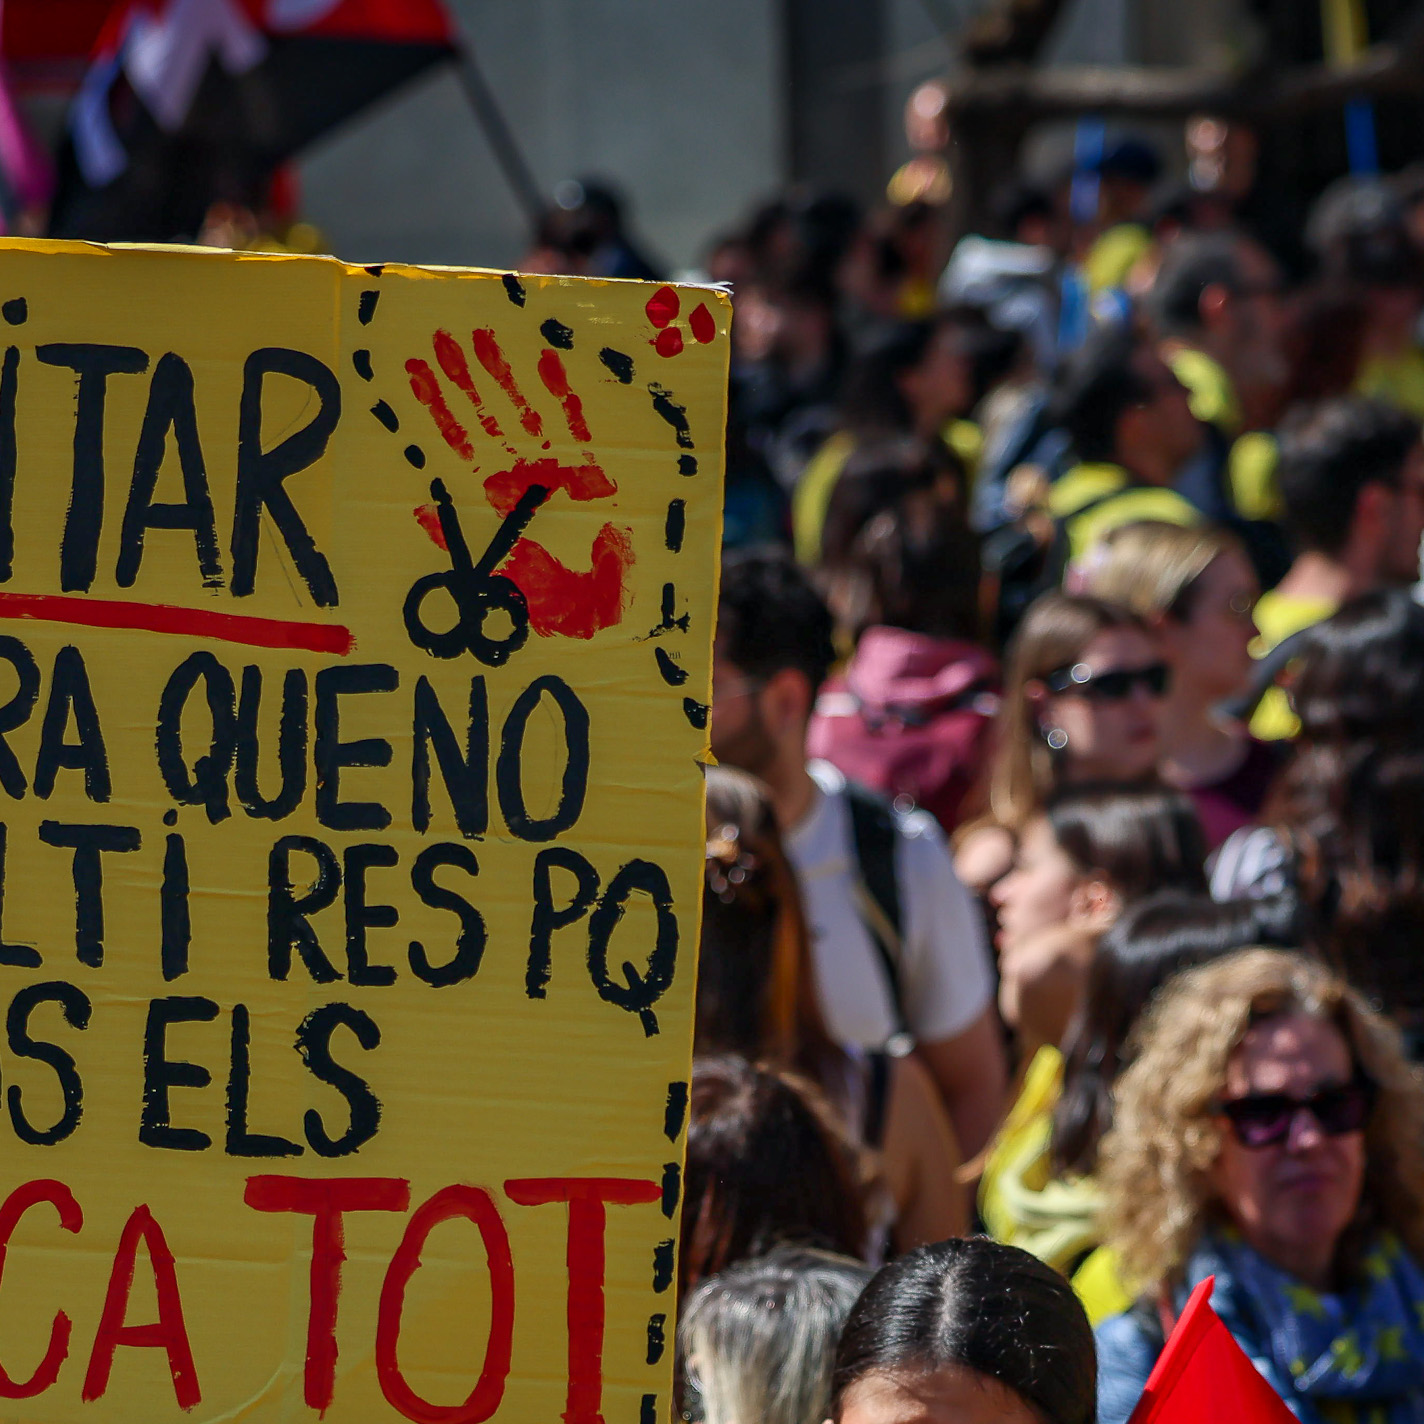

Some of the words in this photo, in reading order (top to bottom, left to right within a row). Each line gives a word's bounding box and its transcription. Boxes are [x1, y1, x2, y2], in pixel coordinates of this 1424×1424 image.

[267, 835, 487, 989] RES
[526, 846, 680, 1038] PQ
[138, 996, 384, 1159] ELS
